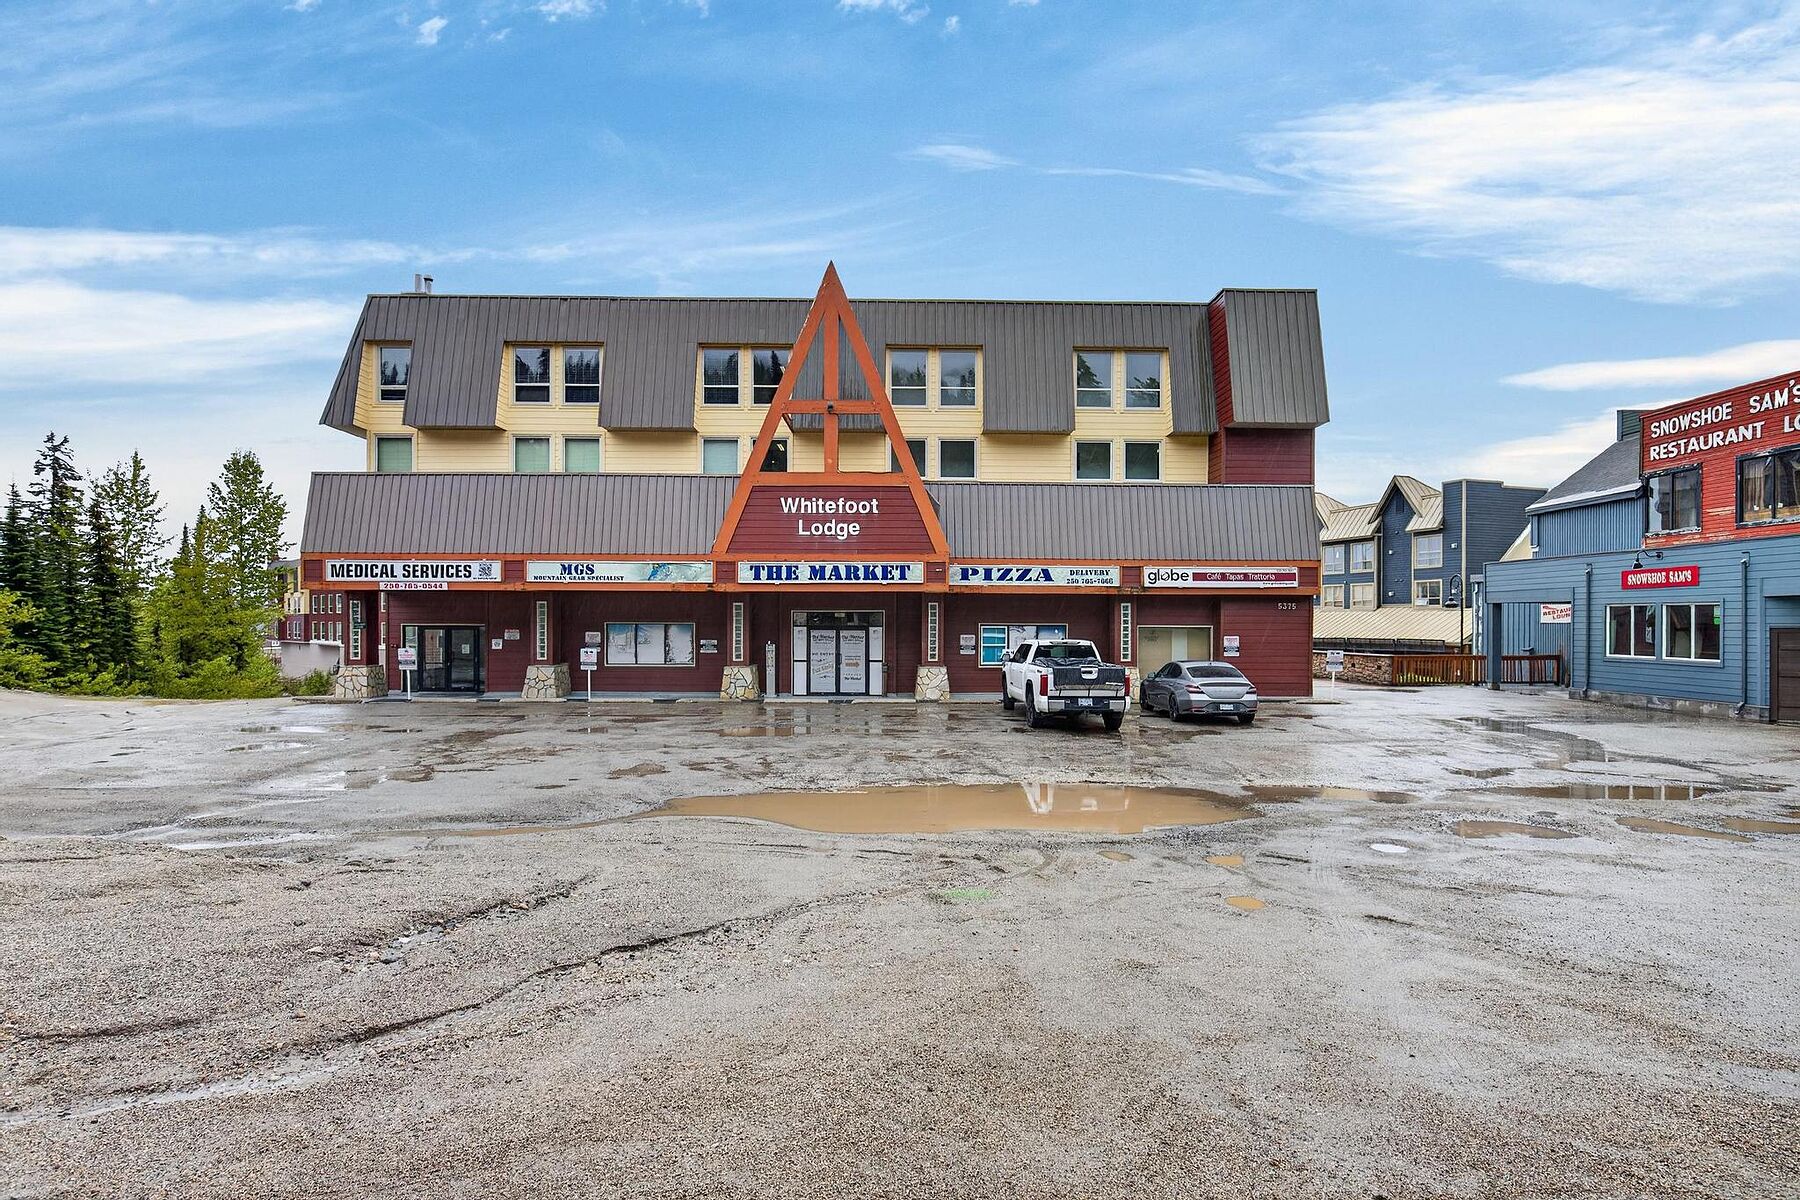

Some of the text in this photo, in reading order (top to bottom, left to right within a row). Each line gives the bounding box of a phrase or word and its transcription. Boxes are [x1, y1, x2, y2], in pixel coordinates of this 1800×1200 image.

[1650, 379, 1800, 438] SNOWSHOE SAM'S
[1650, 421, 1765, 461] RESTAURANT
[780, 497, 879, 514] Whitefoot
[798, 519, 861, 540] Lodge
[330, 563, 472, 579] MEDICAL SERVICES
[559, 563, 596, 576] MGS
[750, 565, 911, 581] THE MARKET
[959, 567, 1055, 582] PIZZA
[1147, 568, 1190, 585] globe
[1206, 572, 1276, 582] Café Tapas Trattoria
[1627, 570, 1692, 586] SNOWSHOE SAM'S
[1277, 602, 1297, 610] 5375
